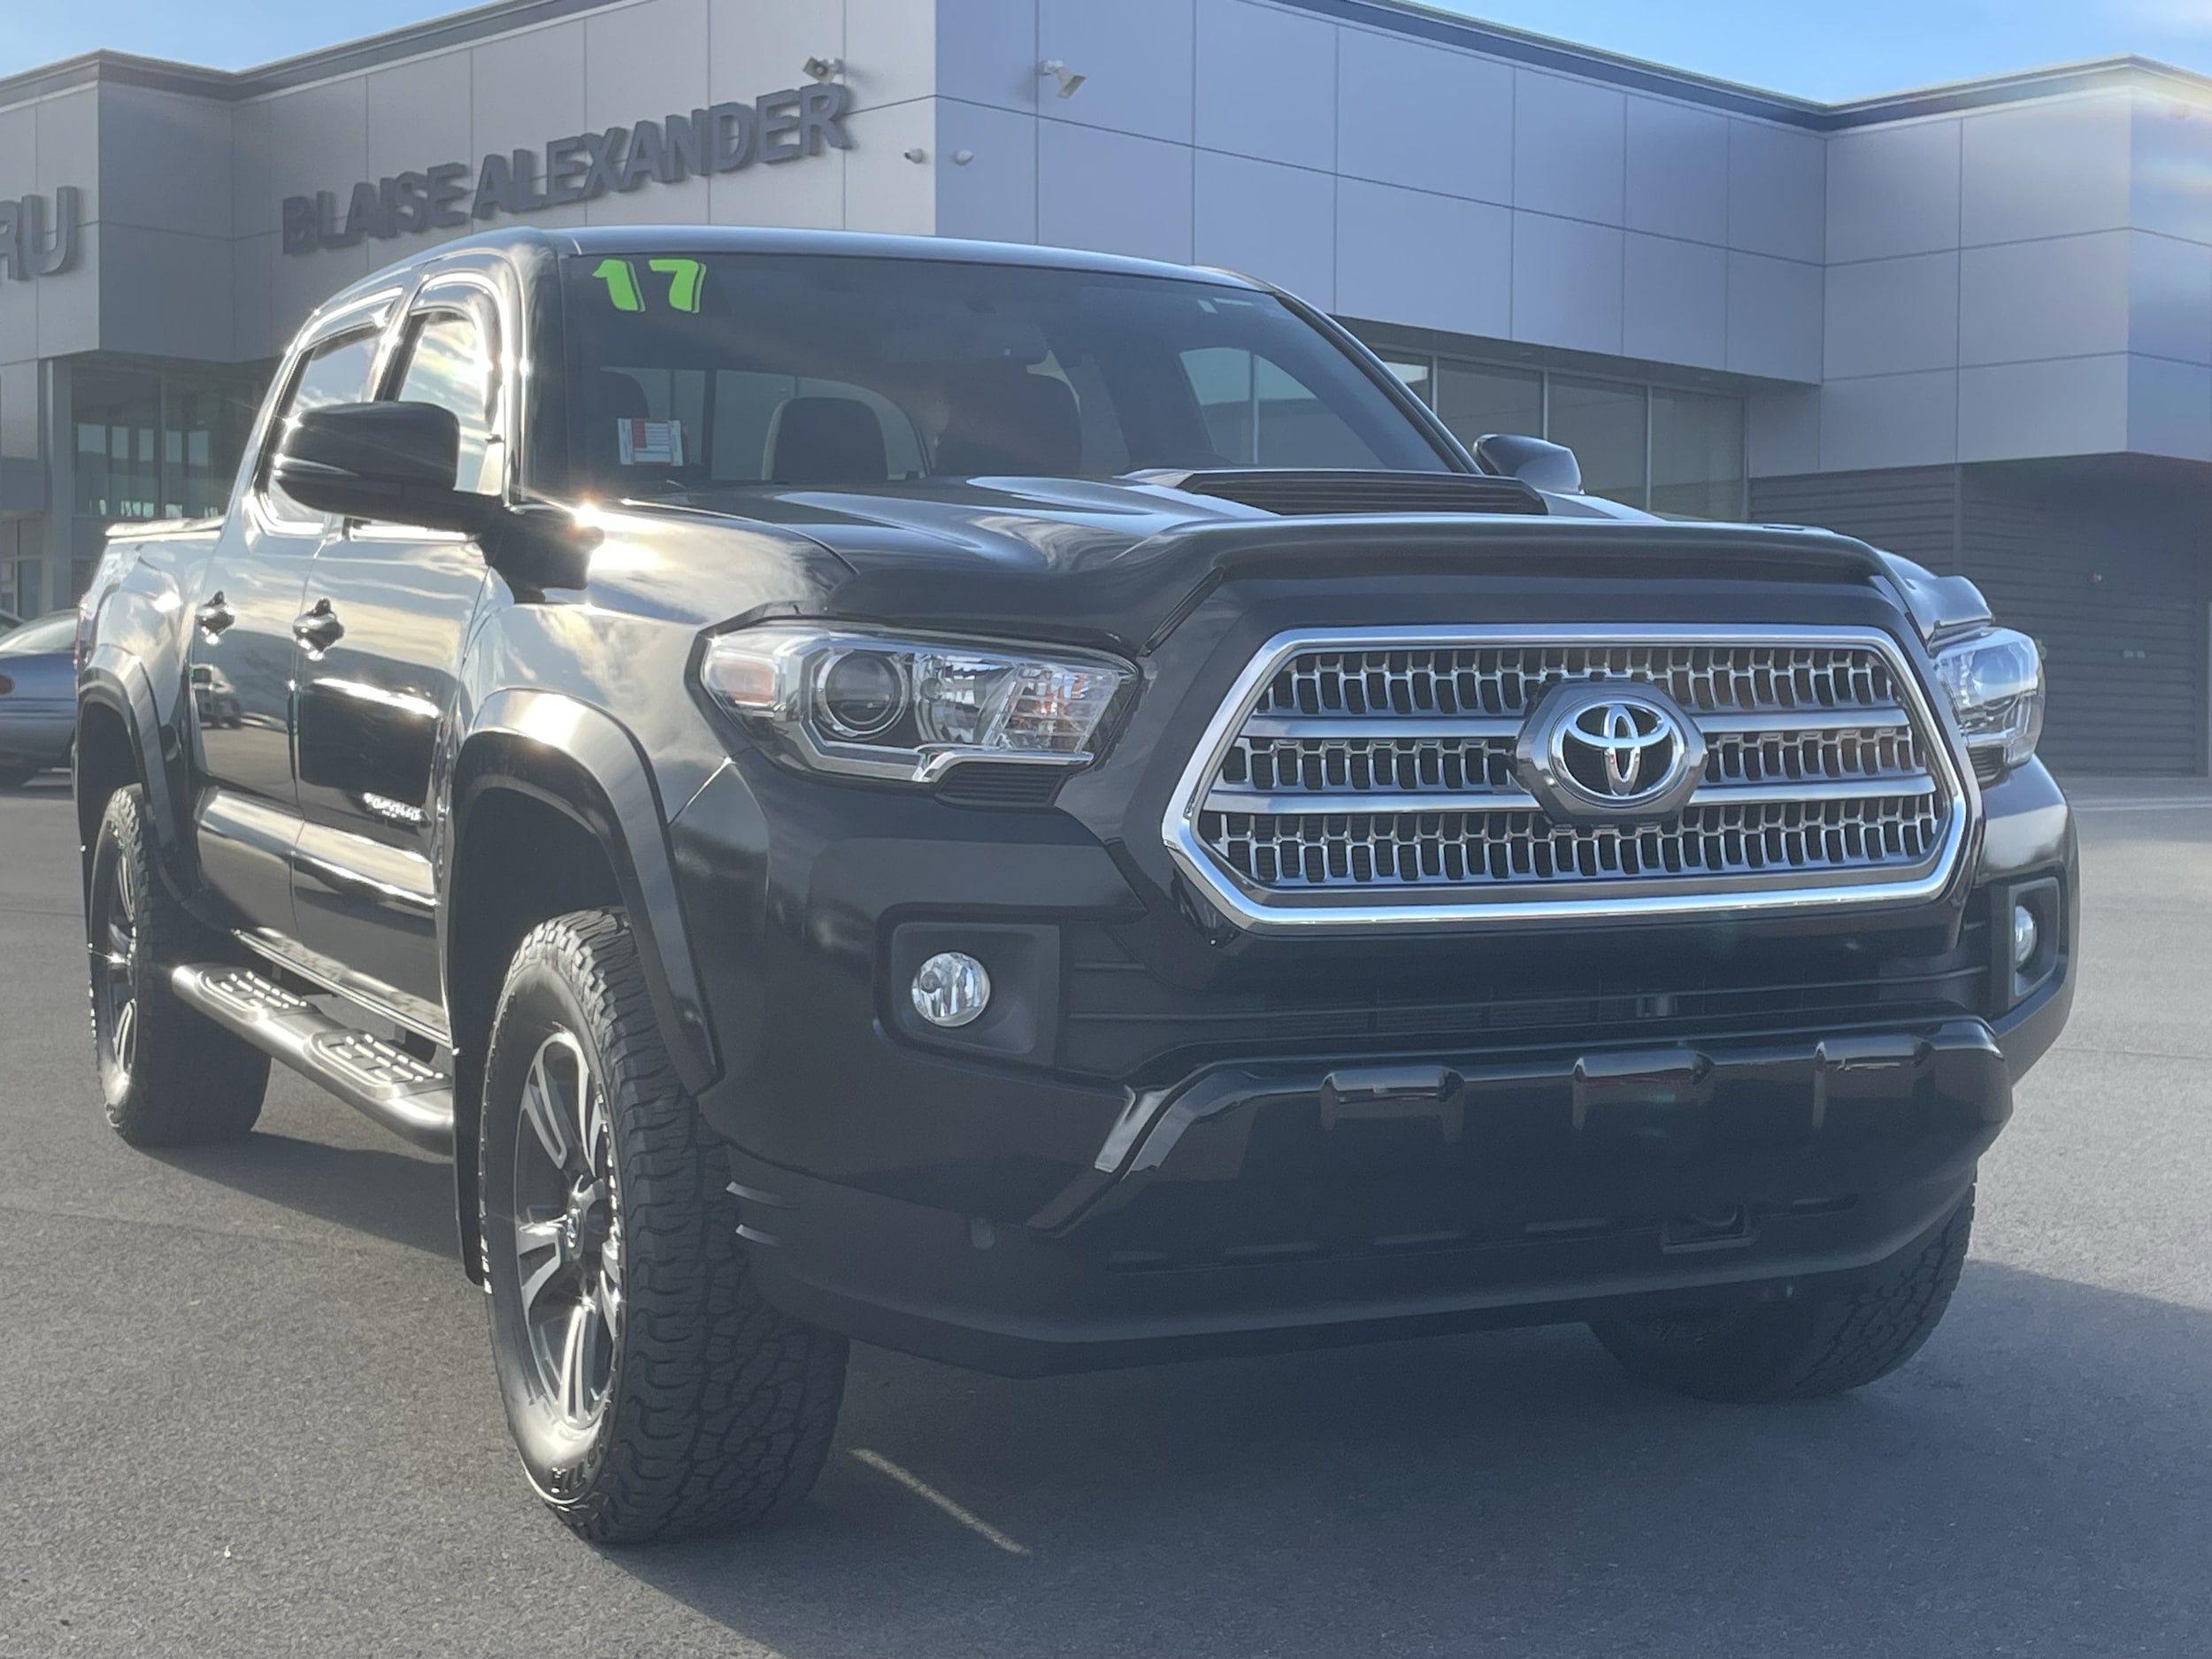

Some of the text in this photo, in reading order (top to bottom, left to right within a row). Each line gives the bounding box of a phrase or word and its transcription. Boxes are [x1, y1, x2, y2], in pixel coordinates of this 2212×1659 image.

[282, 82, 853, 256] BLAISE ALEXANDER
[592, 257, 707, 313] 17
